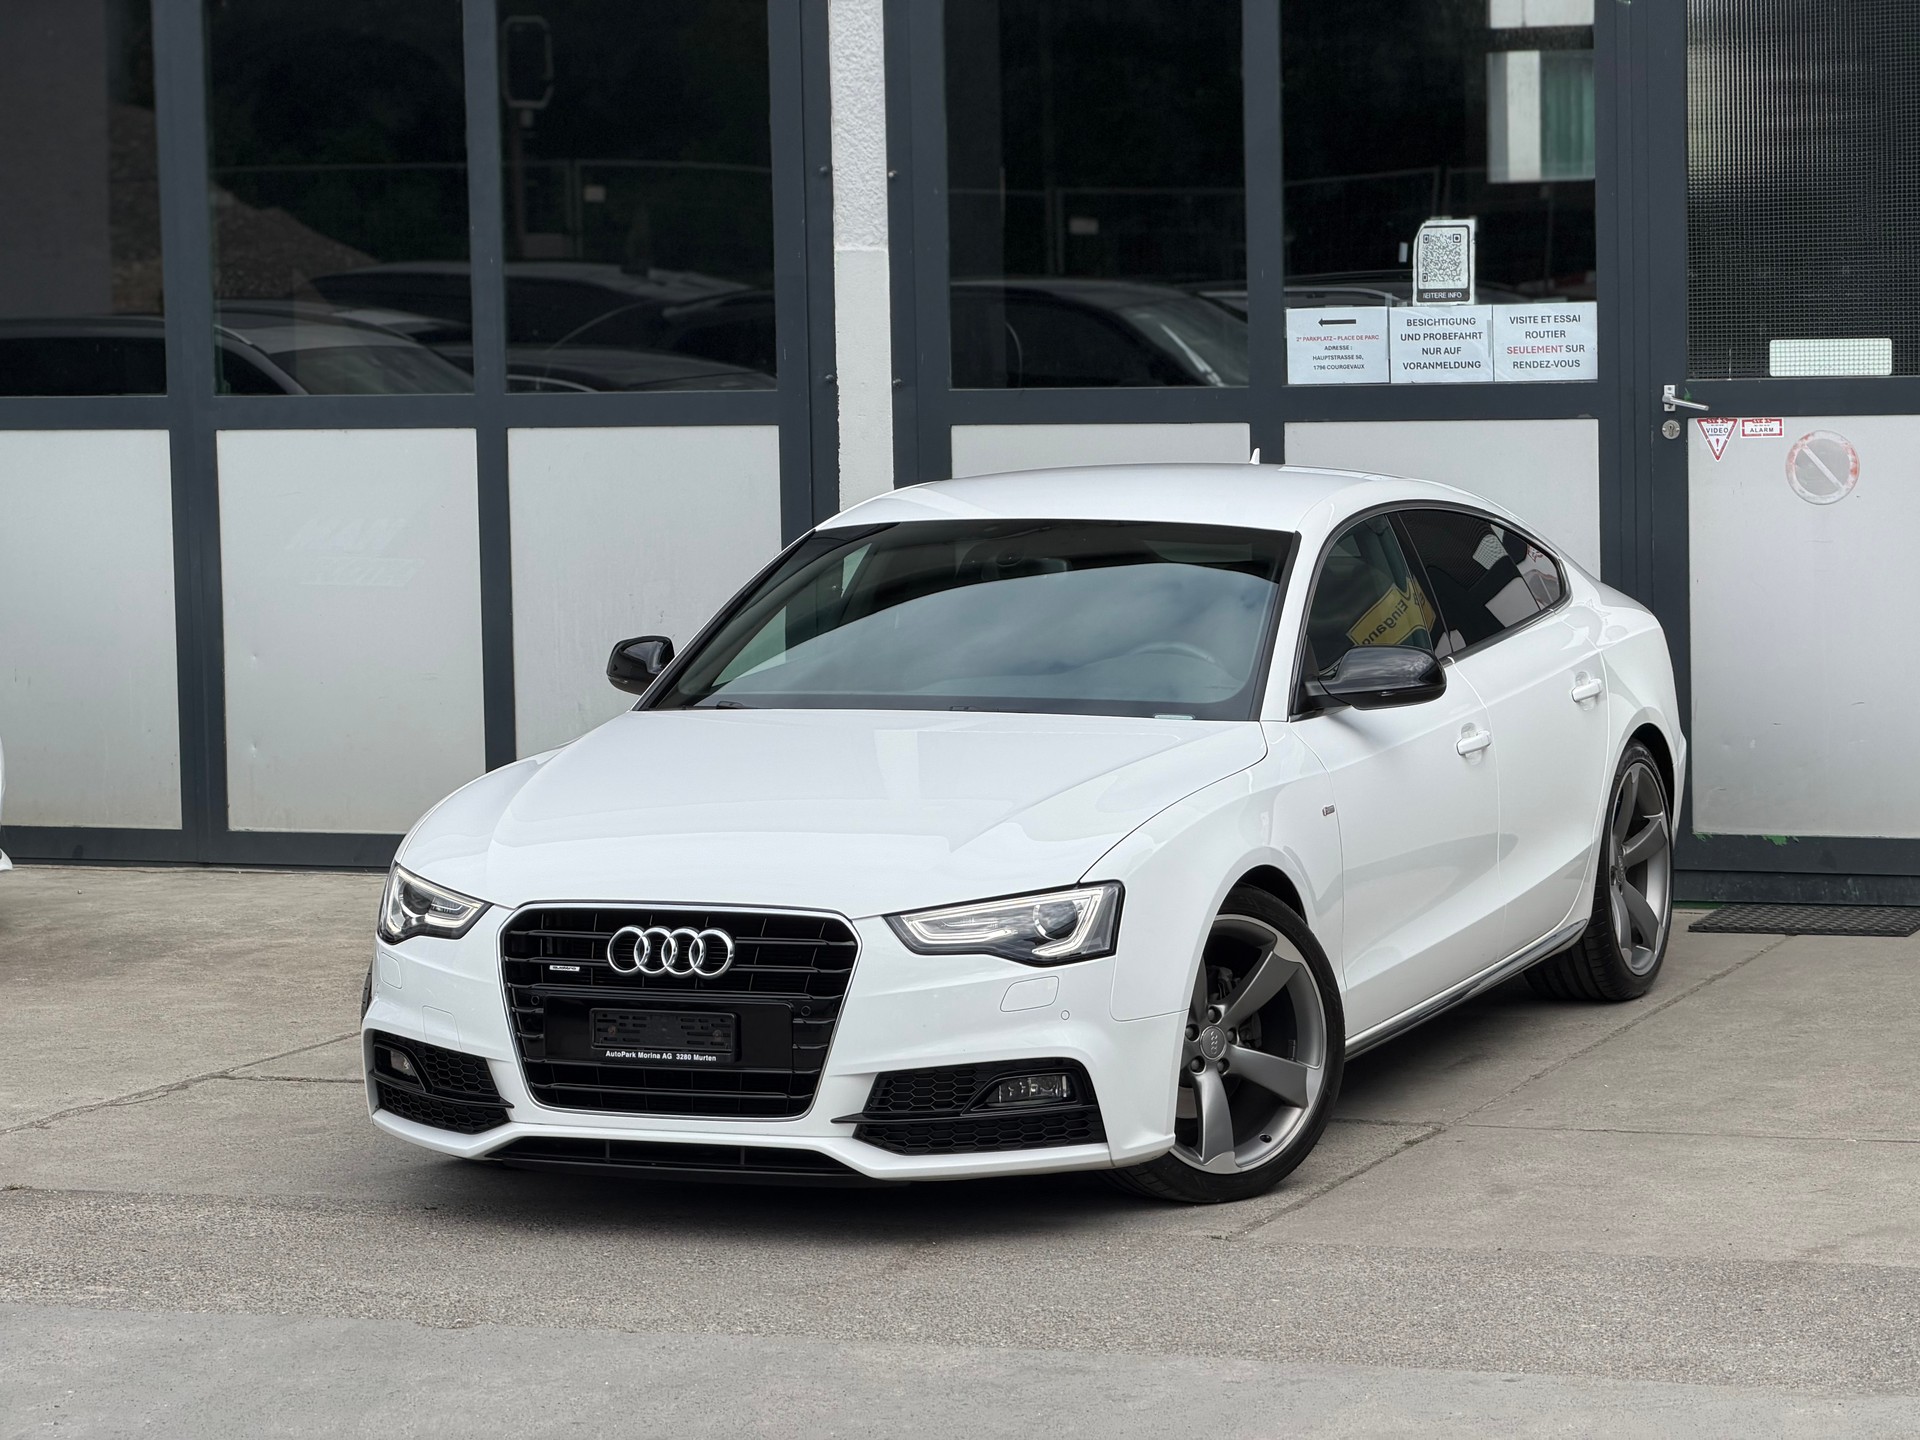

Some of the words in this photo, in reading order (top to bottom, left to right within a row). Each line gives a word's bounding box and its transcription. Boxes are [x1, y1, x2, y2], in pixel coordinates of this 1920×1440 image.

[1448, 291, 1463, 299] INFO
[1406, 317, 1477, 327] BESICHTIGUNG
[1509, 315, 1539, 325] VISITE
[1541, 315, 1552, 324] ET
[1554, 314, 1581, 324] ESSAI
[1400, 333, 1421, 342] UND
[1423, 331, 1483, 341] PROBEFAHRT
[1525, 330, 1567, 339] ROUTIER
[1421, 346, 1442, 356] NUR
[1443, 346, 1462, 356] AUF
[1507, 345, 1564, 355] SEULEMENT
[1566, 344, 1586, 353] SUR
[1402, 361, 1482, 371] VORANMELDUNG
[1512, 359, 1581, 369] RENDEZ-VOUS
[605, 1050, 637, 1058] AutoPark
[637, 1051, 661, 1060] Morina
[662, 1052, 673, 1060] AG
[676, 1053, 692, 1061] 3280
[693, 1054, 717, 1062] Murten
